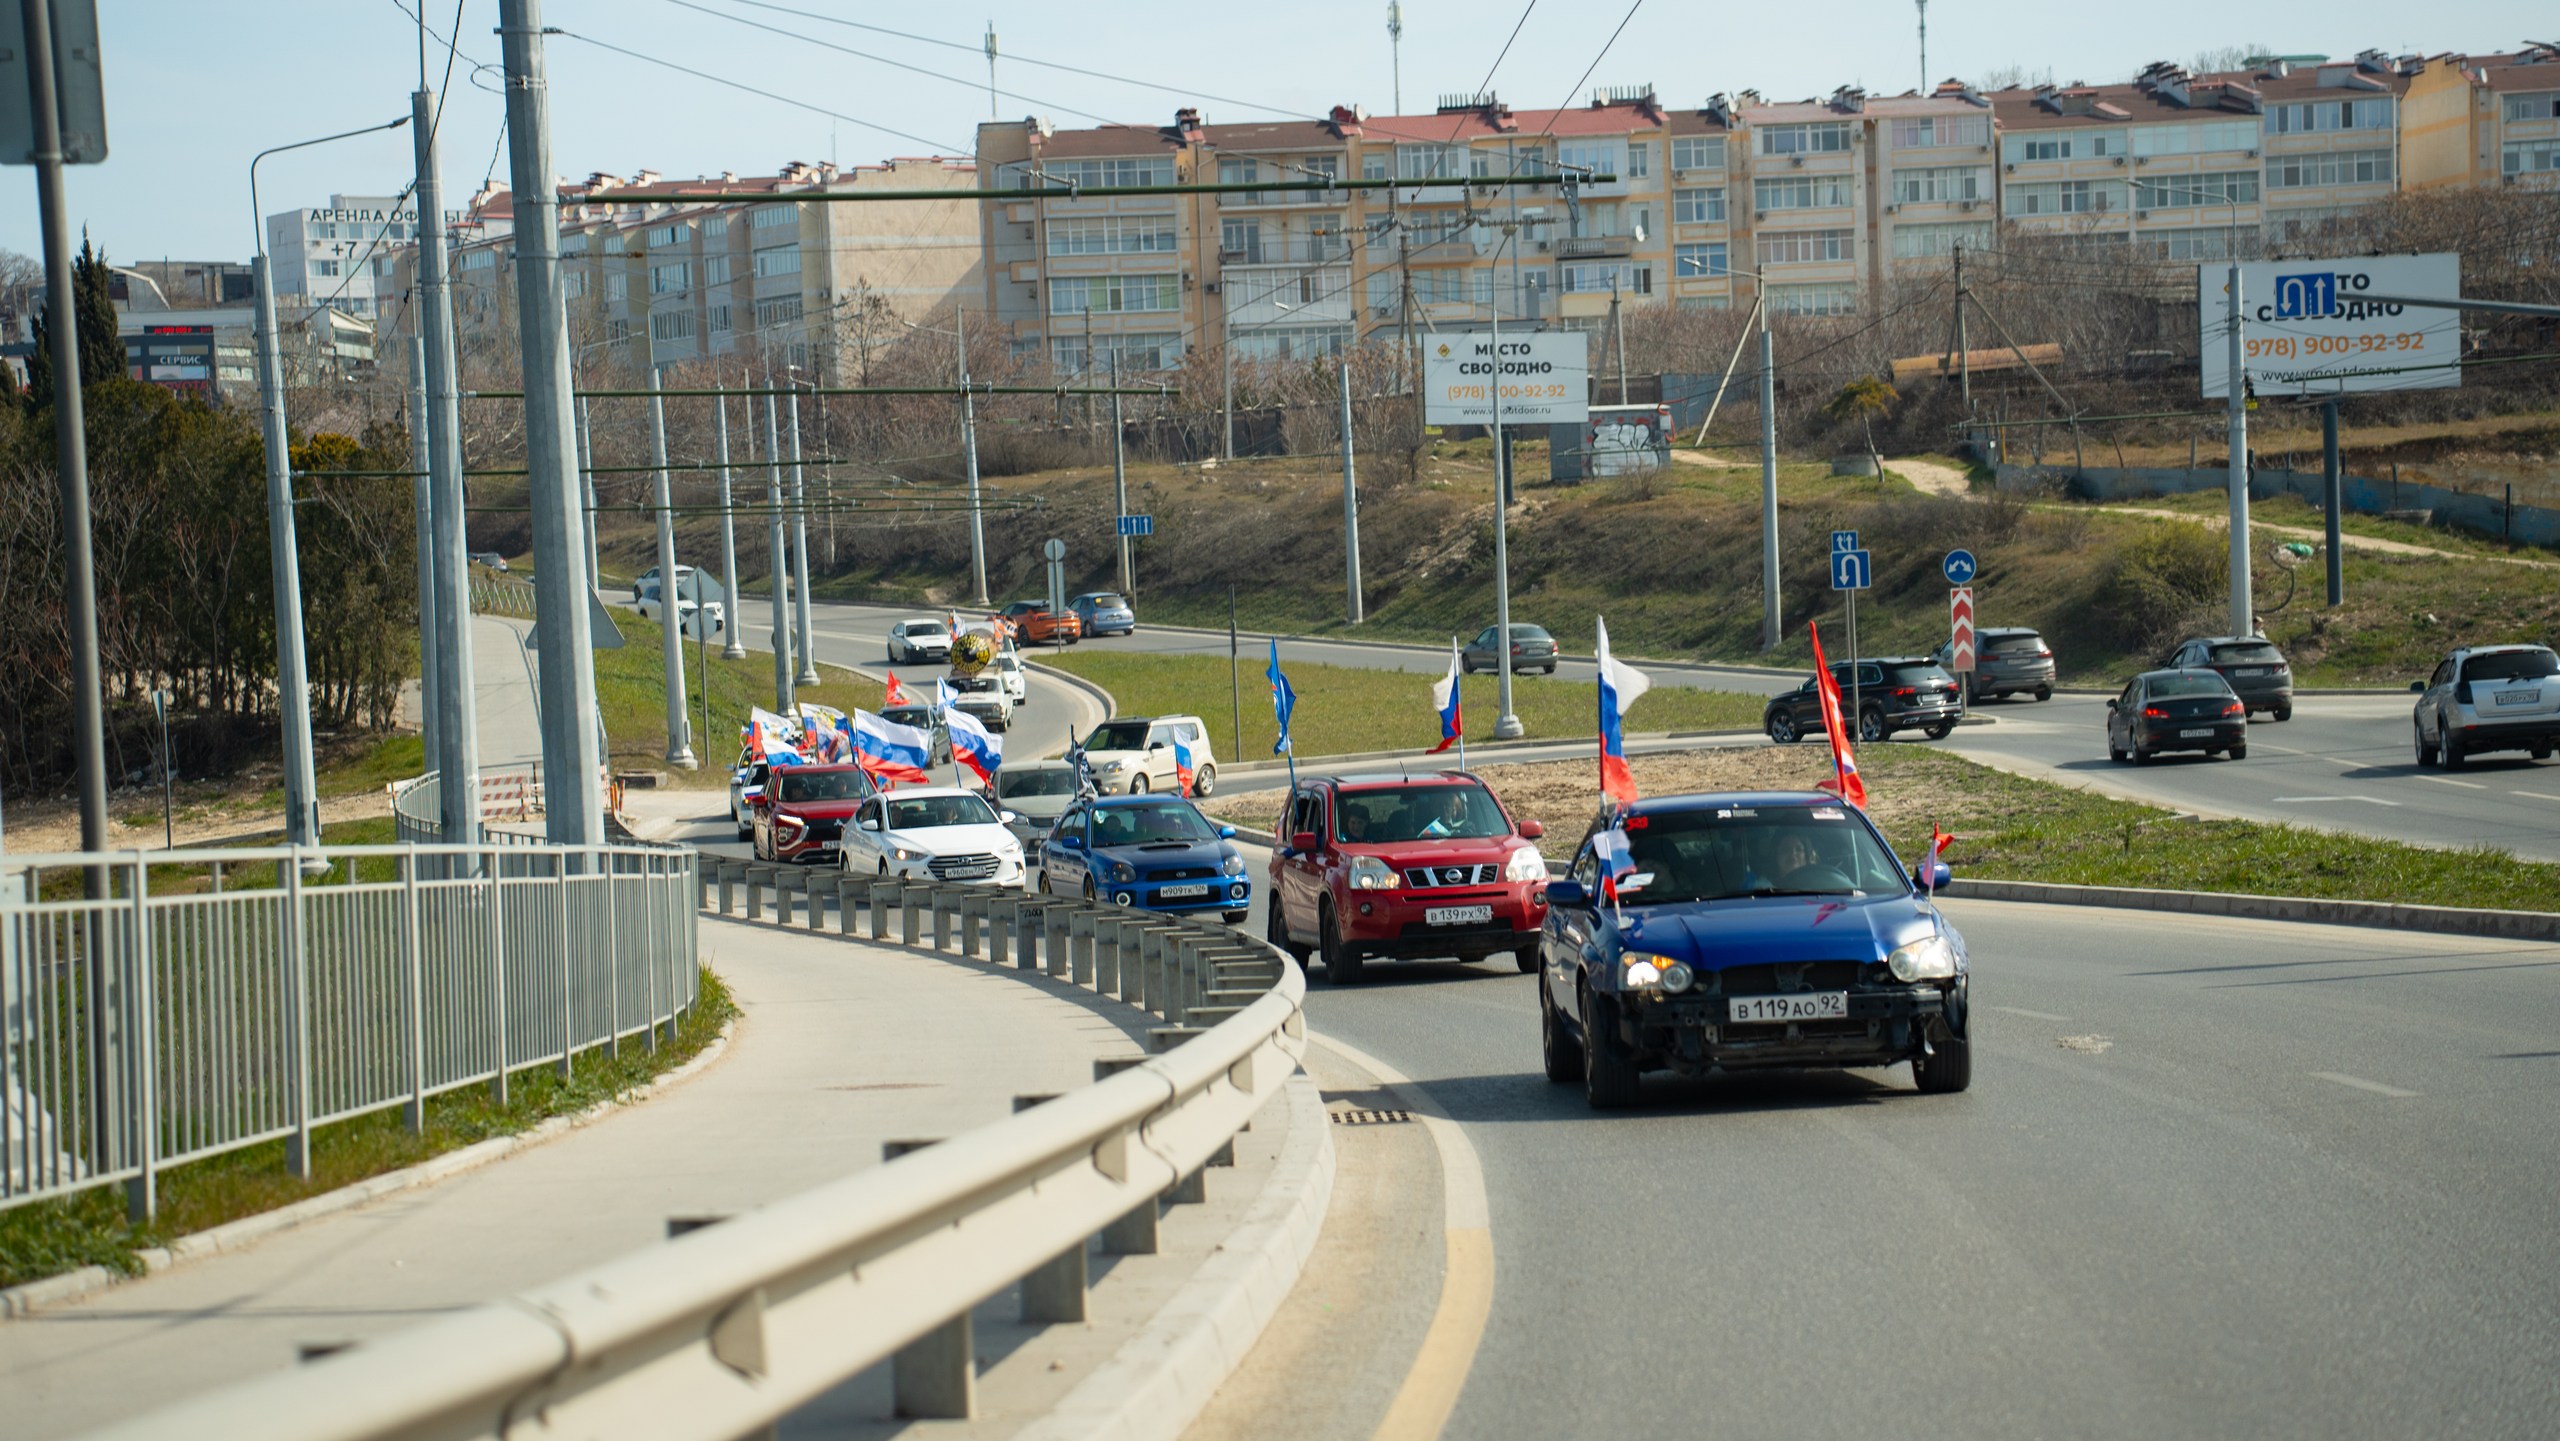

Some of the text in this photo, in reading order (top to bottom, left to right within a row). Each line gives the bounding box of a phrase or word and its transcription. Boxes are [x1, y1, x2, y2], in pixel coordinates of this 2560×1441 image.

[310, 209, 460, 222] АРЕНДА ОФЫ
[2257, 301, 2404, 322] СОДНО
[2244, 332, 2424, 360] 978) 900-92-92
[160, 355, 201, 364] СЕРВИС
[1448, 385, 1485, 401] (978)
[1462, 406, 1551, 416] www.voutdoor.ru
[1820, 995, 1840, 1010] 92
